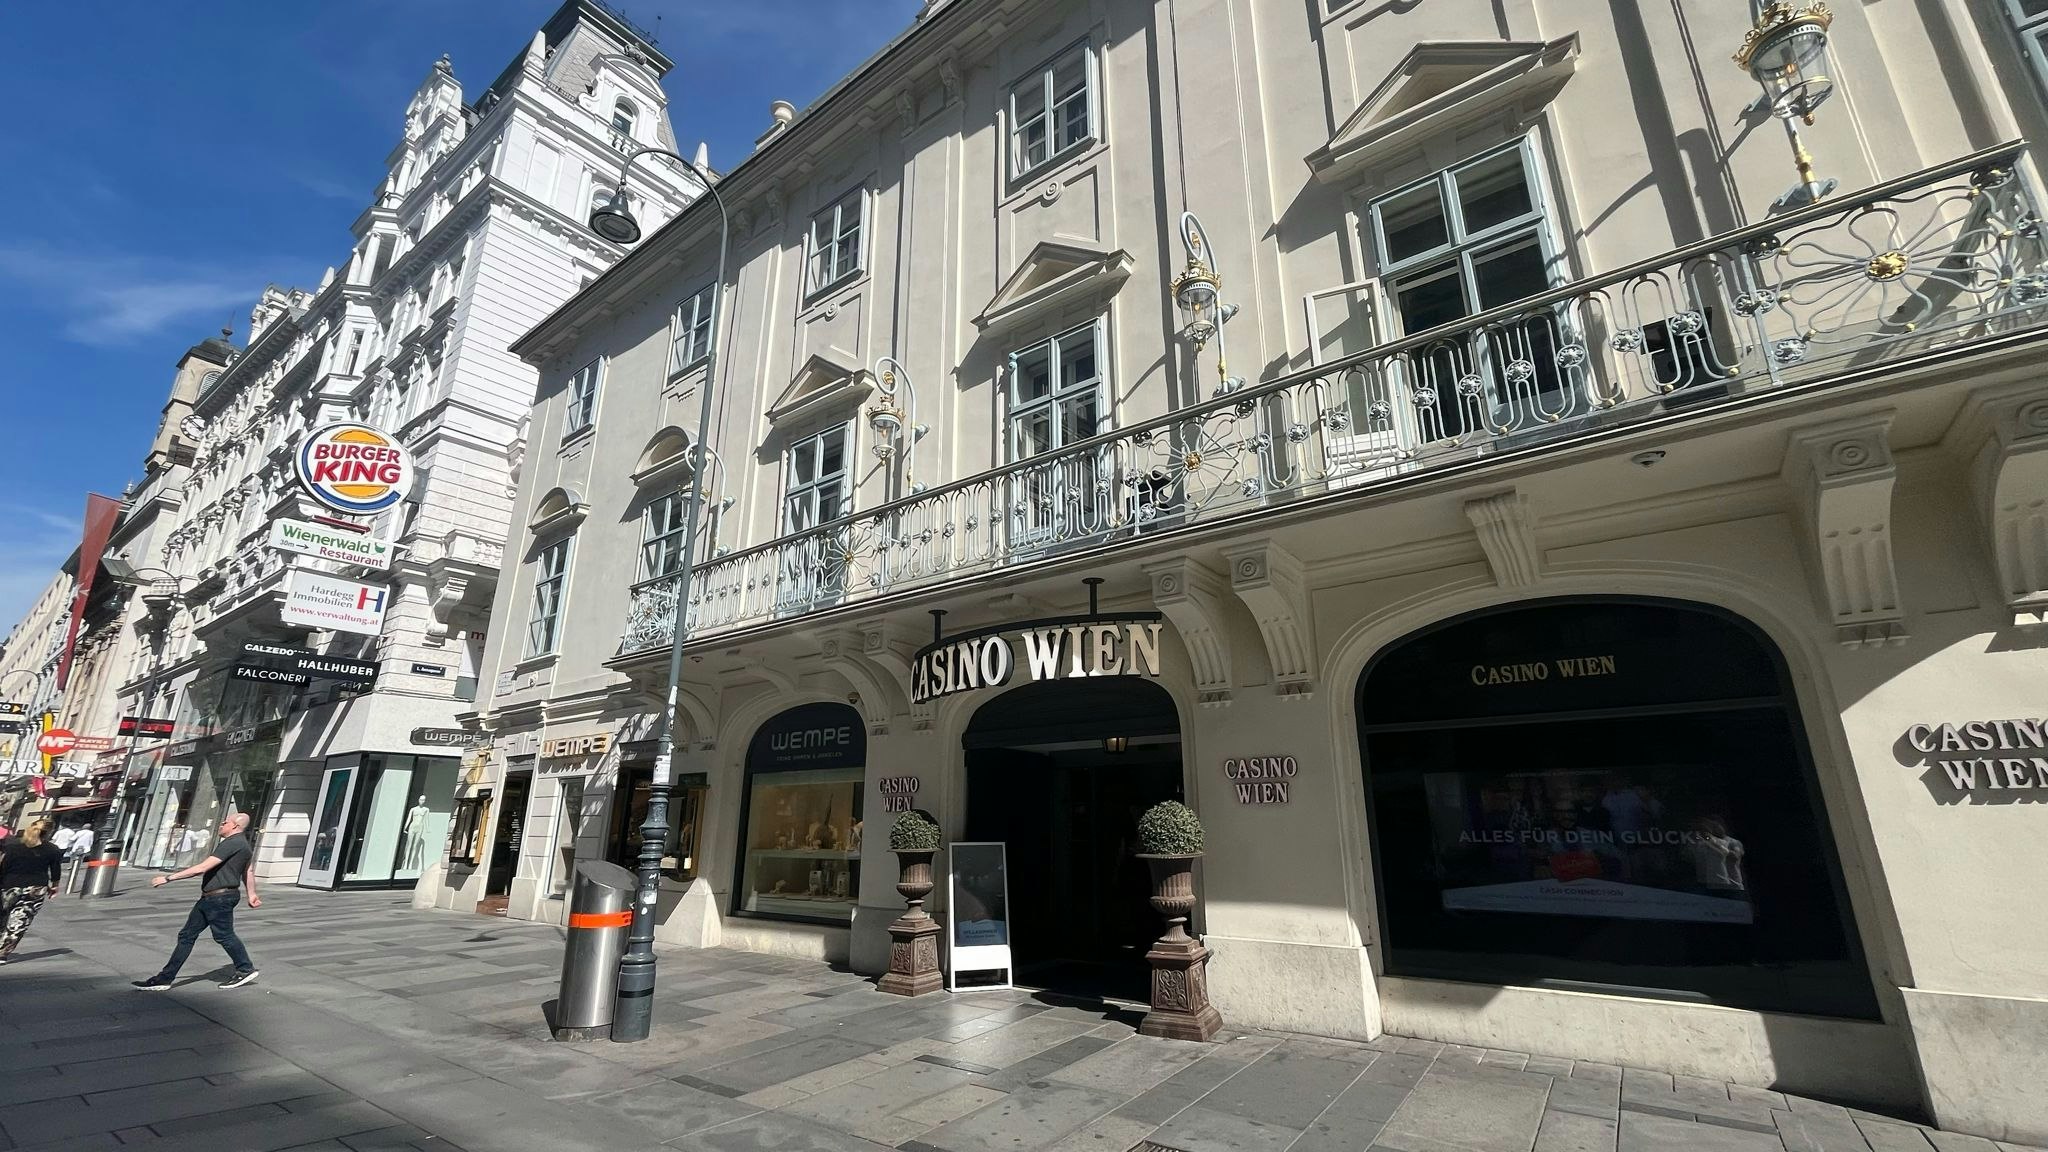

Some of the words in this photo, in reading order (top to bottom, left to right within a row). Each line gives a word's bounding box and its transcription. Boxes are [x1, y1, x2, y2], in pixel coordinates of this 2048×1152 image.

[314, 444, 401, 464] BURGER
[313, 461, 402, 484] KING
[282, 524, 371, 554] Wienerwald
[320, 546, 384, 568] Restaurant
[293, 591, 353, 609] Immobilien
[311, 585, 354, 601] Hardegg
[290, 606, 379, 626] www.verwaltung.at
[244, 643, 310, 656] CALZEDO
[297, 659, 374, 676] HALLHUBER
[910, 636, 1013, 704] CASINO
[1022, 623, 1163, 681] WIEN
[1471, 662, 1549, 686] CASINO
[1556, 655, 1617, 678] WIEN
[237, 667, 306, 683] FALCONERI
[38, 735, 76, 748] MF
[424, 732, 481, 742] WEMPE
[771, 726, 850, 751] WEMPE
[1908, 718, 2048, 753] CASIN
[541, 735, 609, 758] WEMPE
[1224, 756, 1298, 780] CASINO
[878, 776, 919, 794] CASINO
[1235, 782, 1289, 804] WIEN
[883, 796, 913, 812] WIEN
[1458, 829, 1515, 843] ALLES
[1520, 827, 1558, 843] FÜR
[1565, 829, 1614, 844] DEIN
[1620, 827, 1706, 845] GLÜCK
